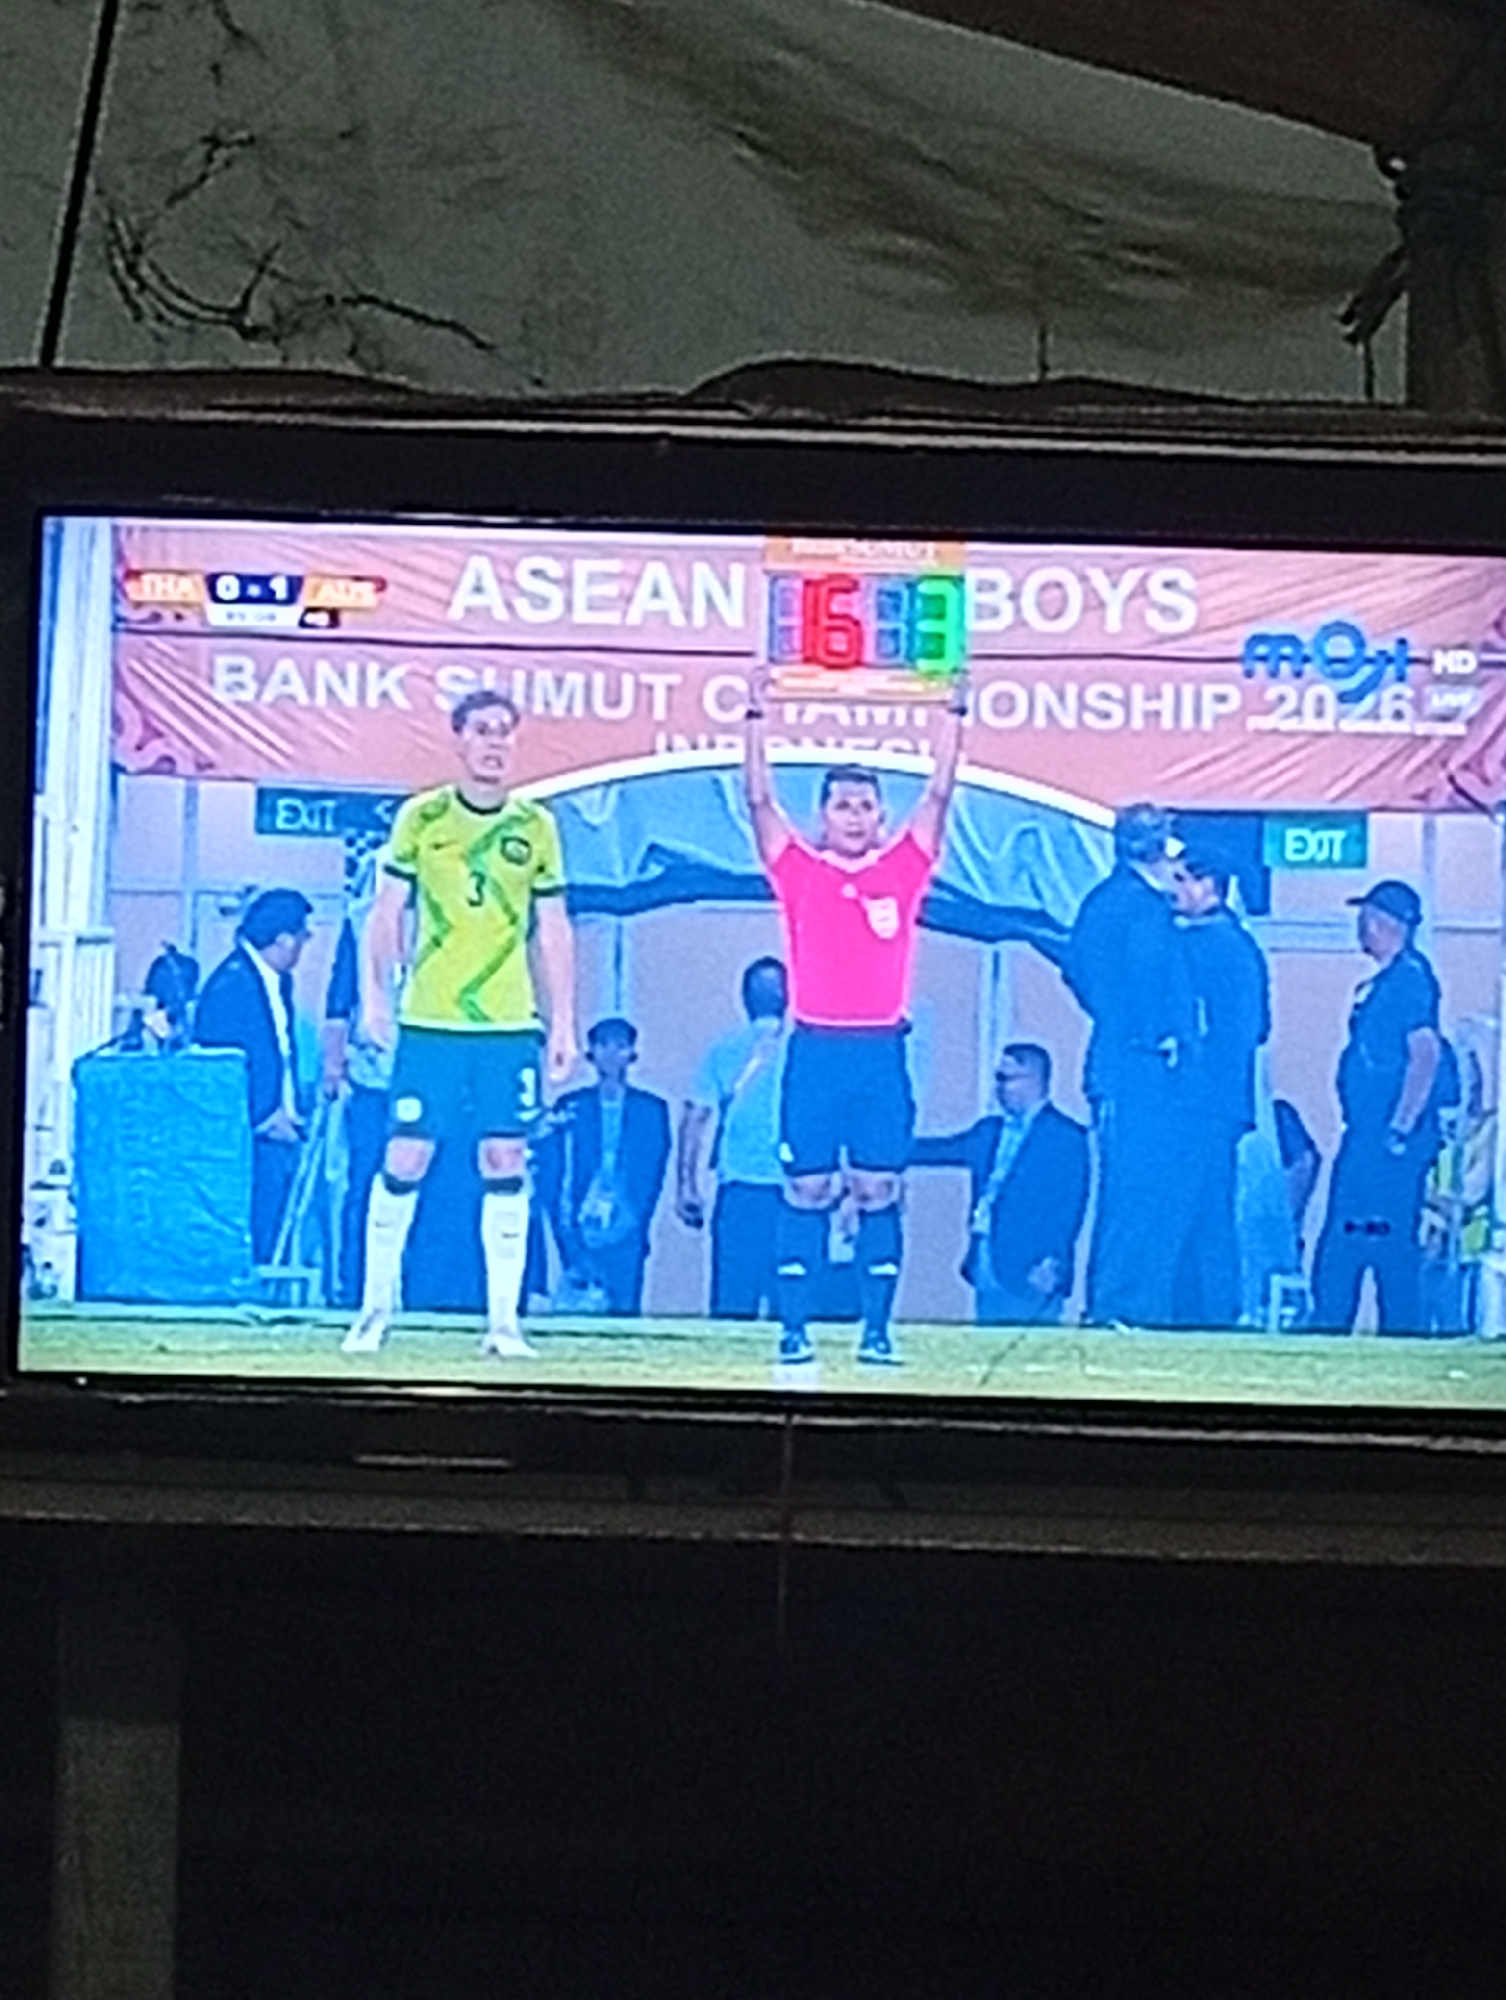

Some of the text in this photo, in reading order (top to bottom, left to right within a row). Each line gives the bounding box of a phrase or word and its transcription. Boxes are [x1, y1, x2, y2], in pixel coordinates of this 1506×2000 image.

[216, 574, 240, 601] 0
[269, 574, 288, 601] 1
[448, 555, 1197, 634] ASEAN BOYS
[1432, 650, 1478, 674] HD
[213, 656, 412, 710] BANK
[275, 797, 336, 831] EXIT
[1284, 828, 1348, 862] EXIT
[468, 871, 486, 907] 3
